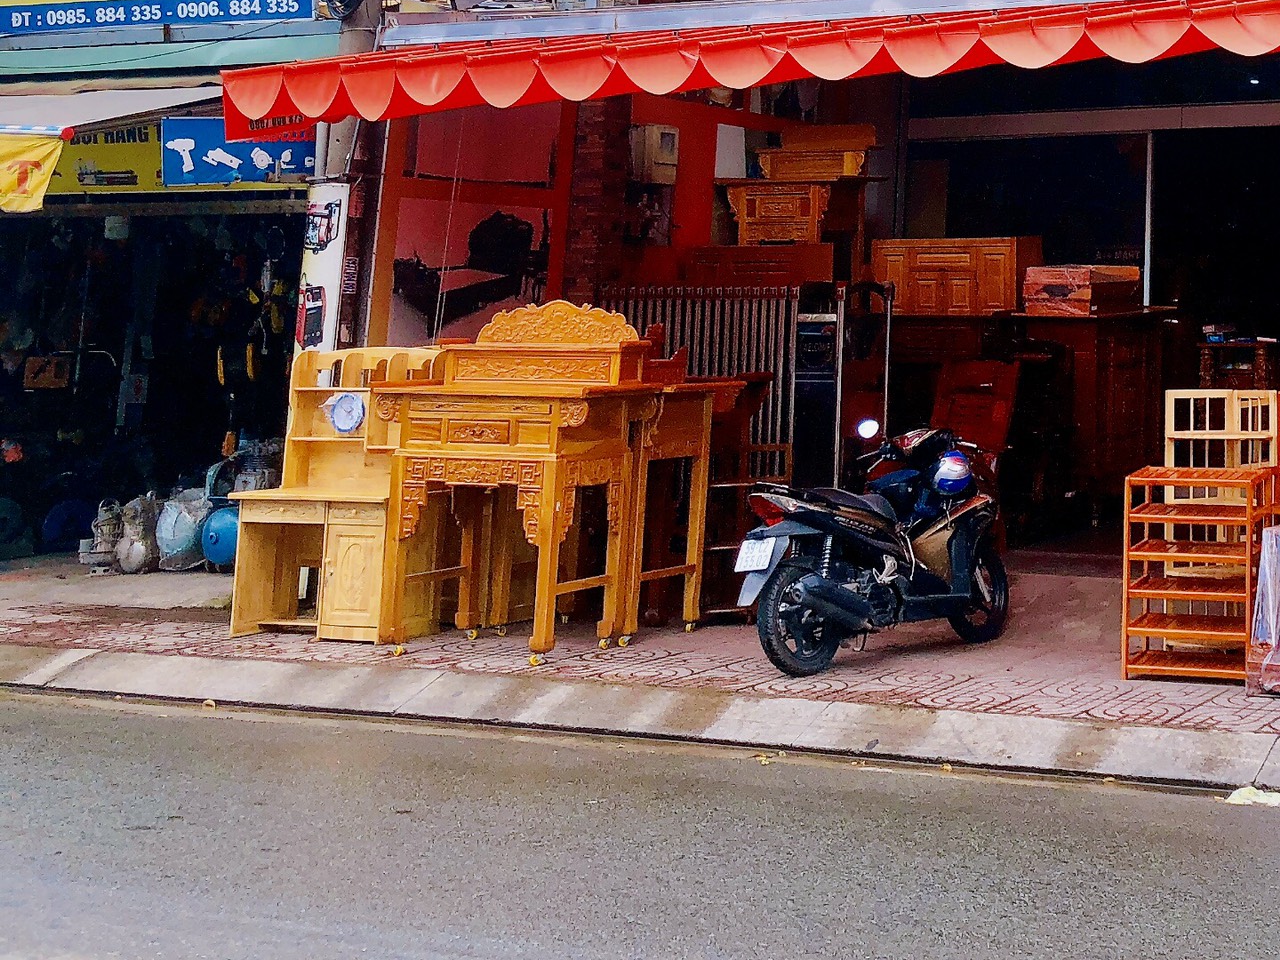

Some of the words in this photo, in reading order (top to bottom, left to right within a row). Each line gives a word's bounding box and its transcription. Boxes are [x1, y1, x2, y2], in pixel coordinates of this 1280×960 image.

[11, 12, 31, 27] ĐT
[46, 10, 91, 26] 0985.
[95, 7, 125, 23] 884
[131, 5, 161, 21] 335
[177, 1, 224, 19] 0906.
[229, 0, 261, 15] 884
